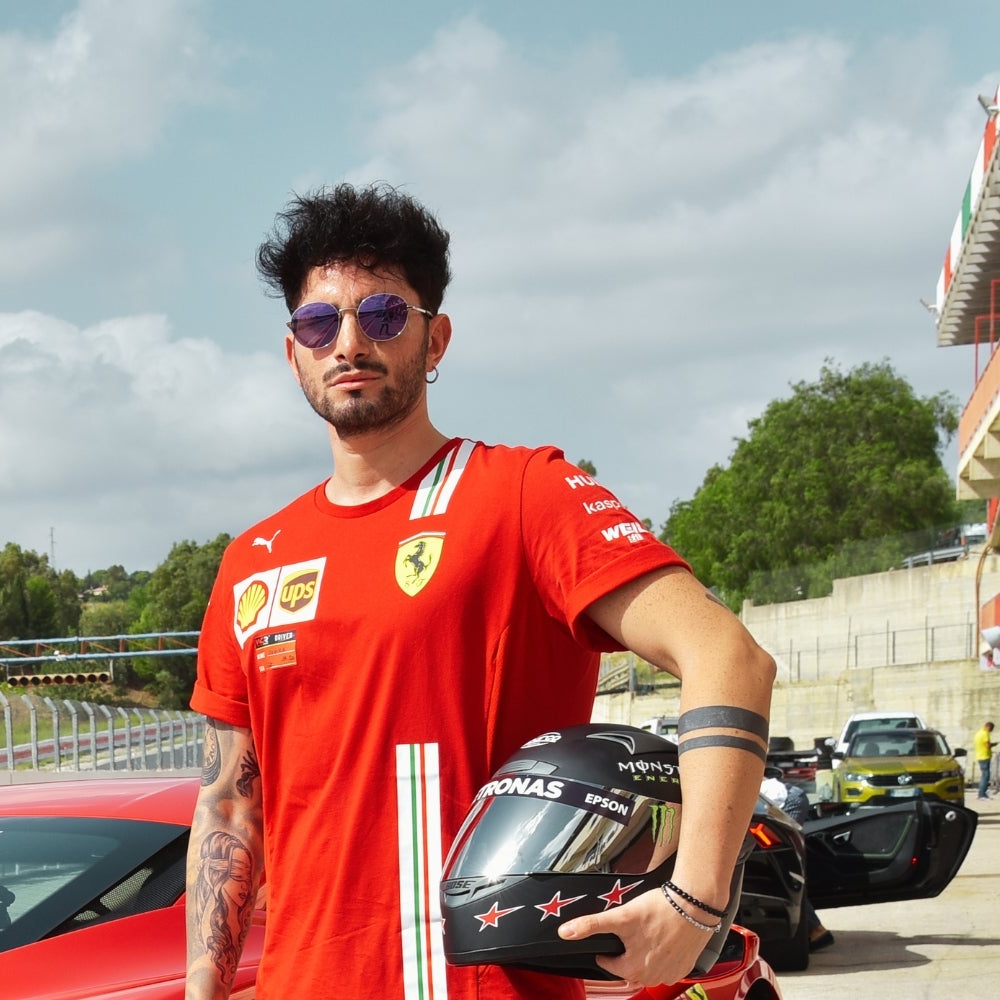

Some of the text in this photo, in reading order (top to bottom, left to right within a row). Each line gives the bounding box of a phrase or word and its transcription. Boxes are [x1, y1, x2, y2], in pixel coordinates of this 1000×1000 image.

[281, 579, 316, 608] ups
[474, 778, 565, 802] TRONAS
[584, 793, 630, 816] EPSON
